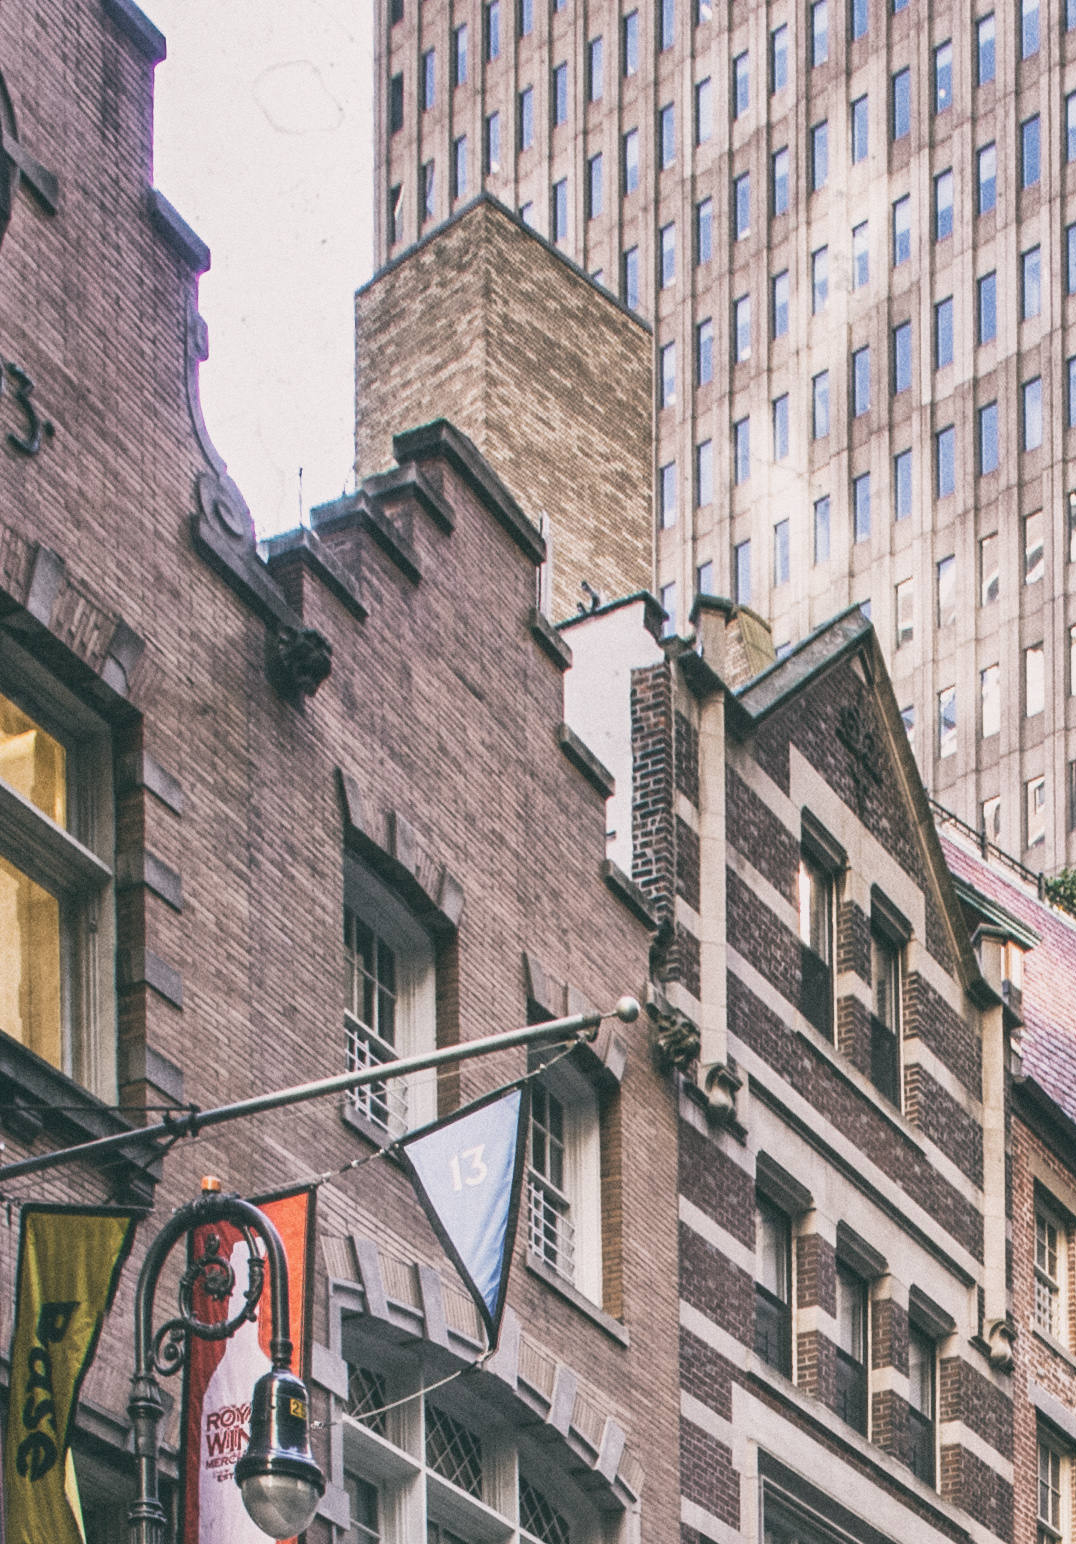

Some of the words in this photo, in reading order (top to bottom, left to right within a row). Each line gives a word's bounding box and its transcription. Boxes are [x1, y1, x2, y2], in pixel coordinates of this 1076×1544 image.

[448, 1144, 488, 1191] 13
[207, 1405, 251, 1432] ROY
[206, 1428, 250, 1457] WIN
